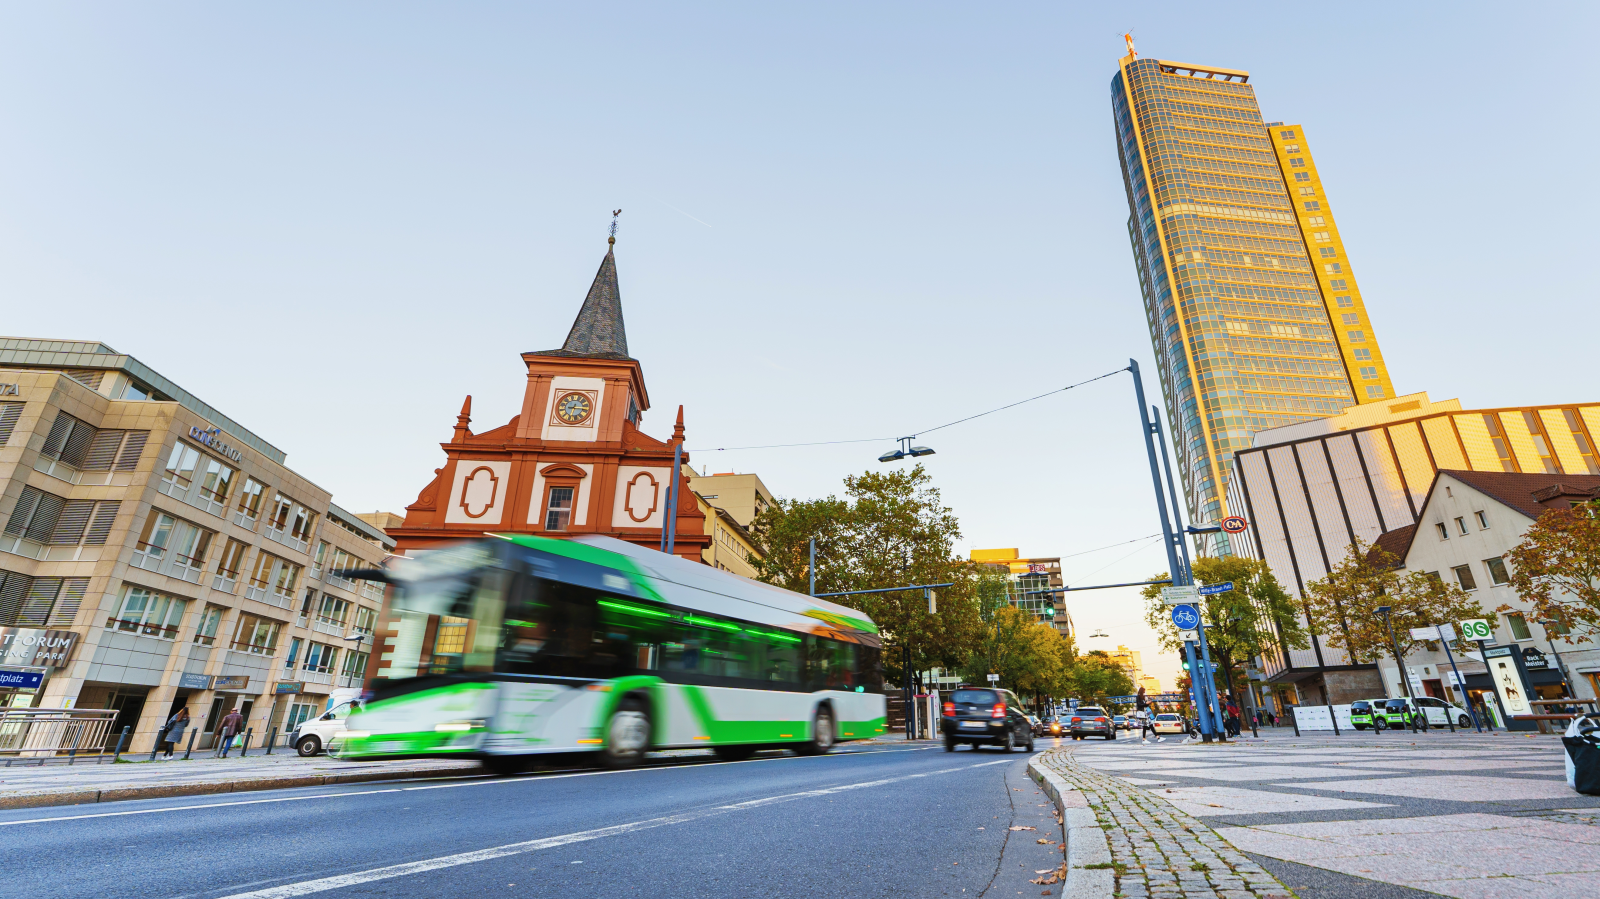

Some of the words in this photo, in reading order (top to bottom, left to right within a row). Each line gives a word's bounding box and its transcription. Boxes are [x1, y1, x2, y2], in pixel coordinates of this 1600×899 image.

[189, 426, 242, 463] CONSCIENTA
[1464, 625, 1472, 636] S
[1475, 622, 1488, 636] S
[0, 634, 70, 649] TFORUM
[36, 651, 65, 660] PARK
